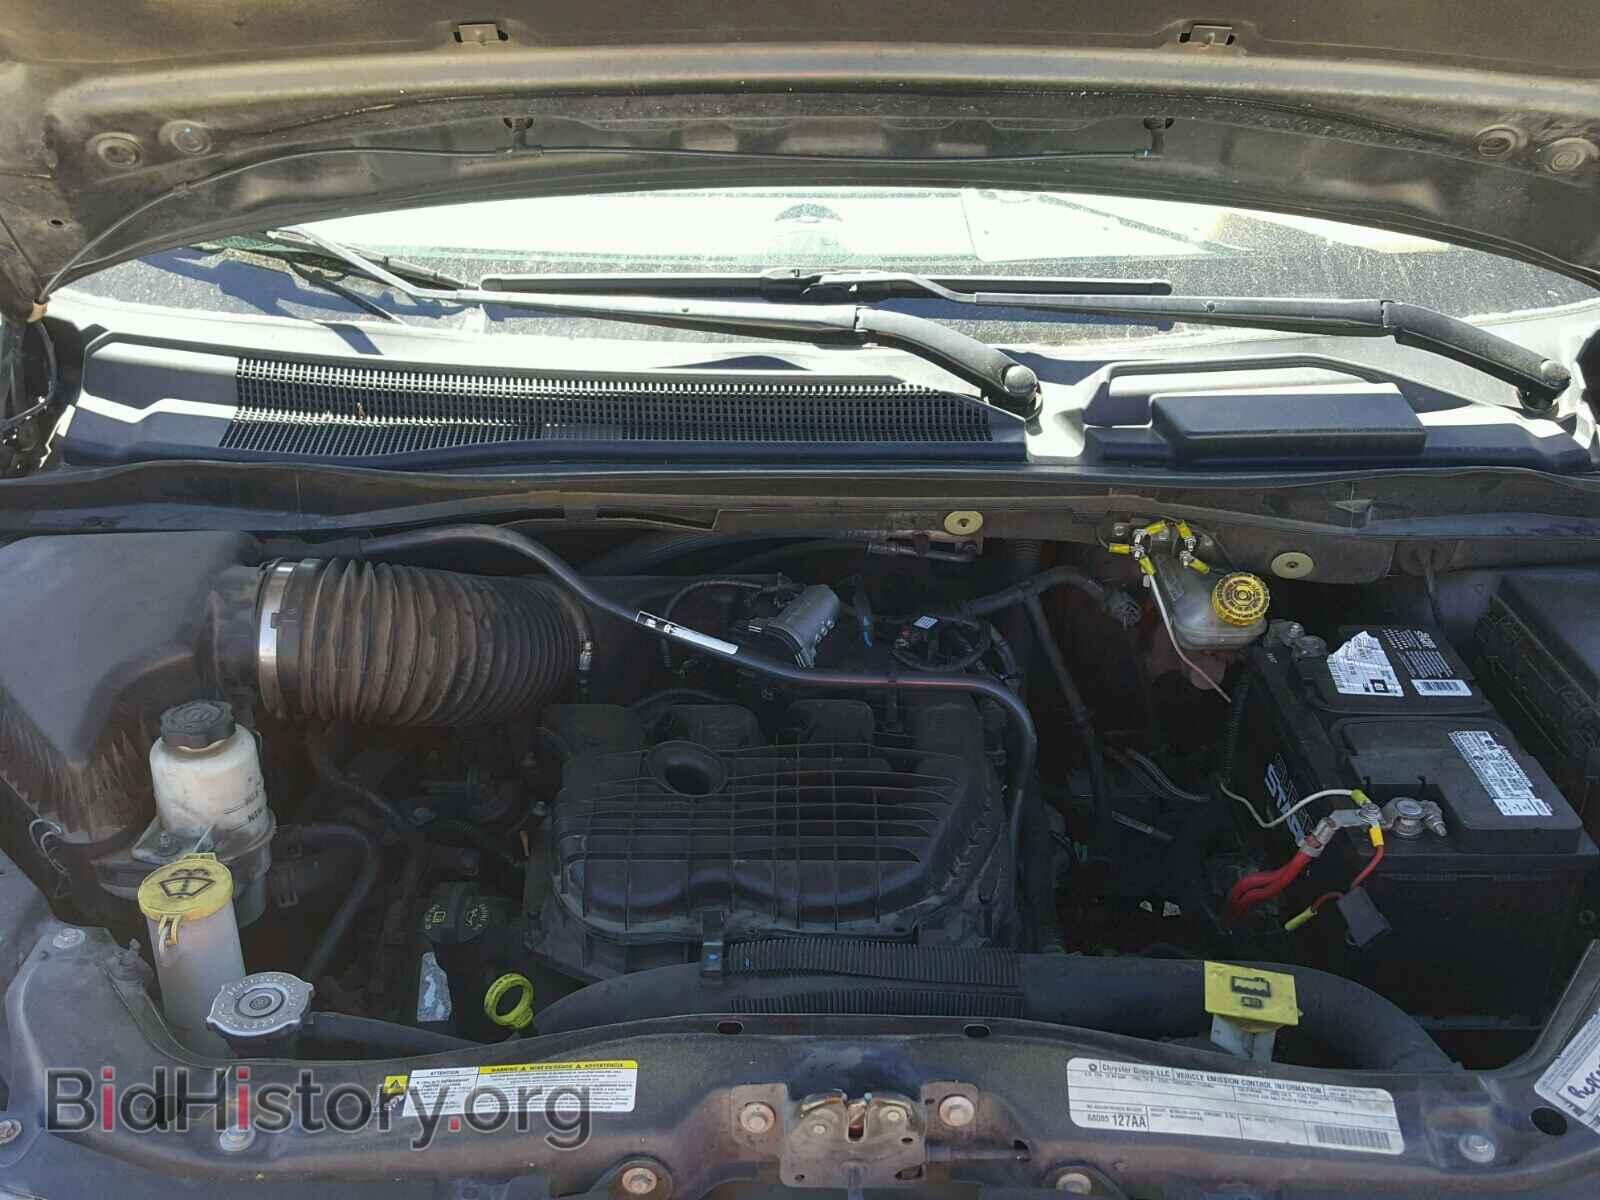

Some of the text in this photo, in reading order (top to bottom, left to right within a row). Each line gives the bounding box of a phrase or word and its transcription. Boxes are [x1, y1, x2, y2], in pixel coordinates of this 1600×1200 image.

[1102, 1063, 1131, 1074] Chrysler
[1156, 1069, 1170, 1078] LLC
[1176, 1072, 1205, 1081] VEHICLE
[1206, 1075, 1239, 1085] EMISSION
[1241, 1079, 1273, 1089] CONTROL
[1275, 1083, 1323, 1094] INFORMATION
[1112, 1113, 1147, 1128] 127AA
